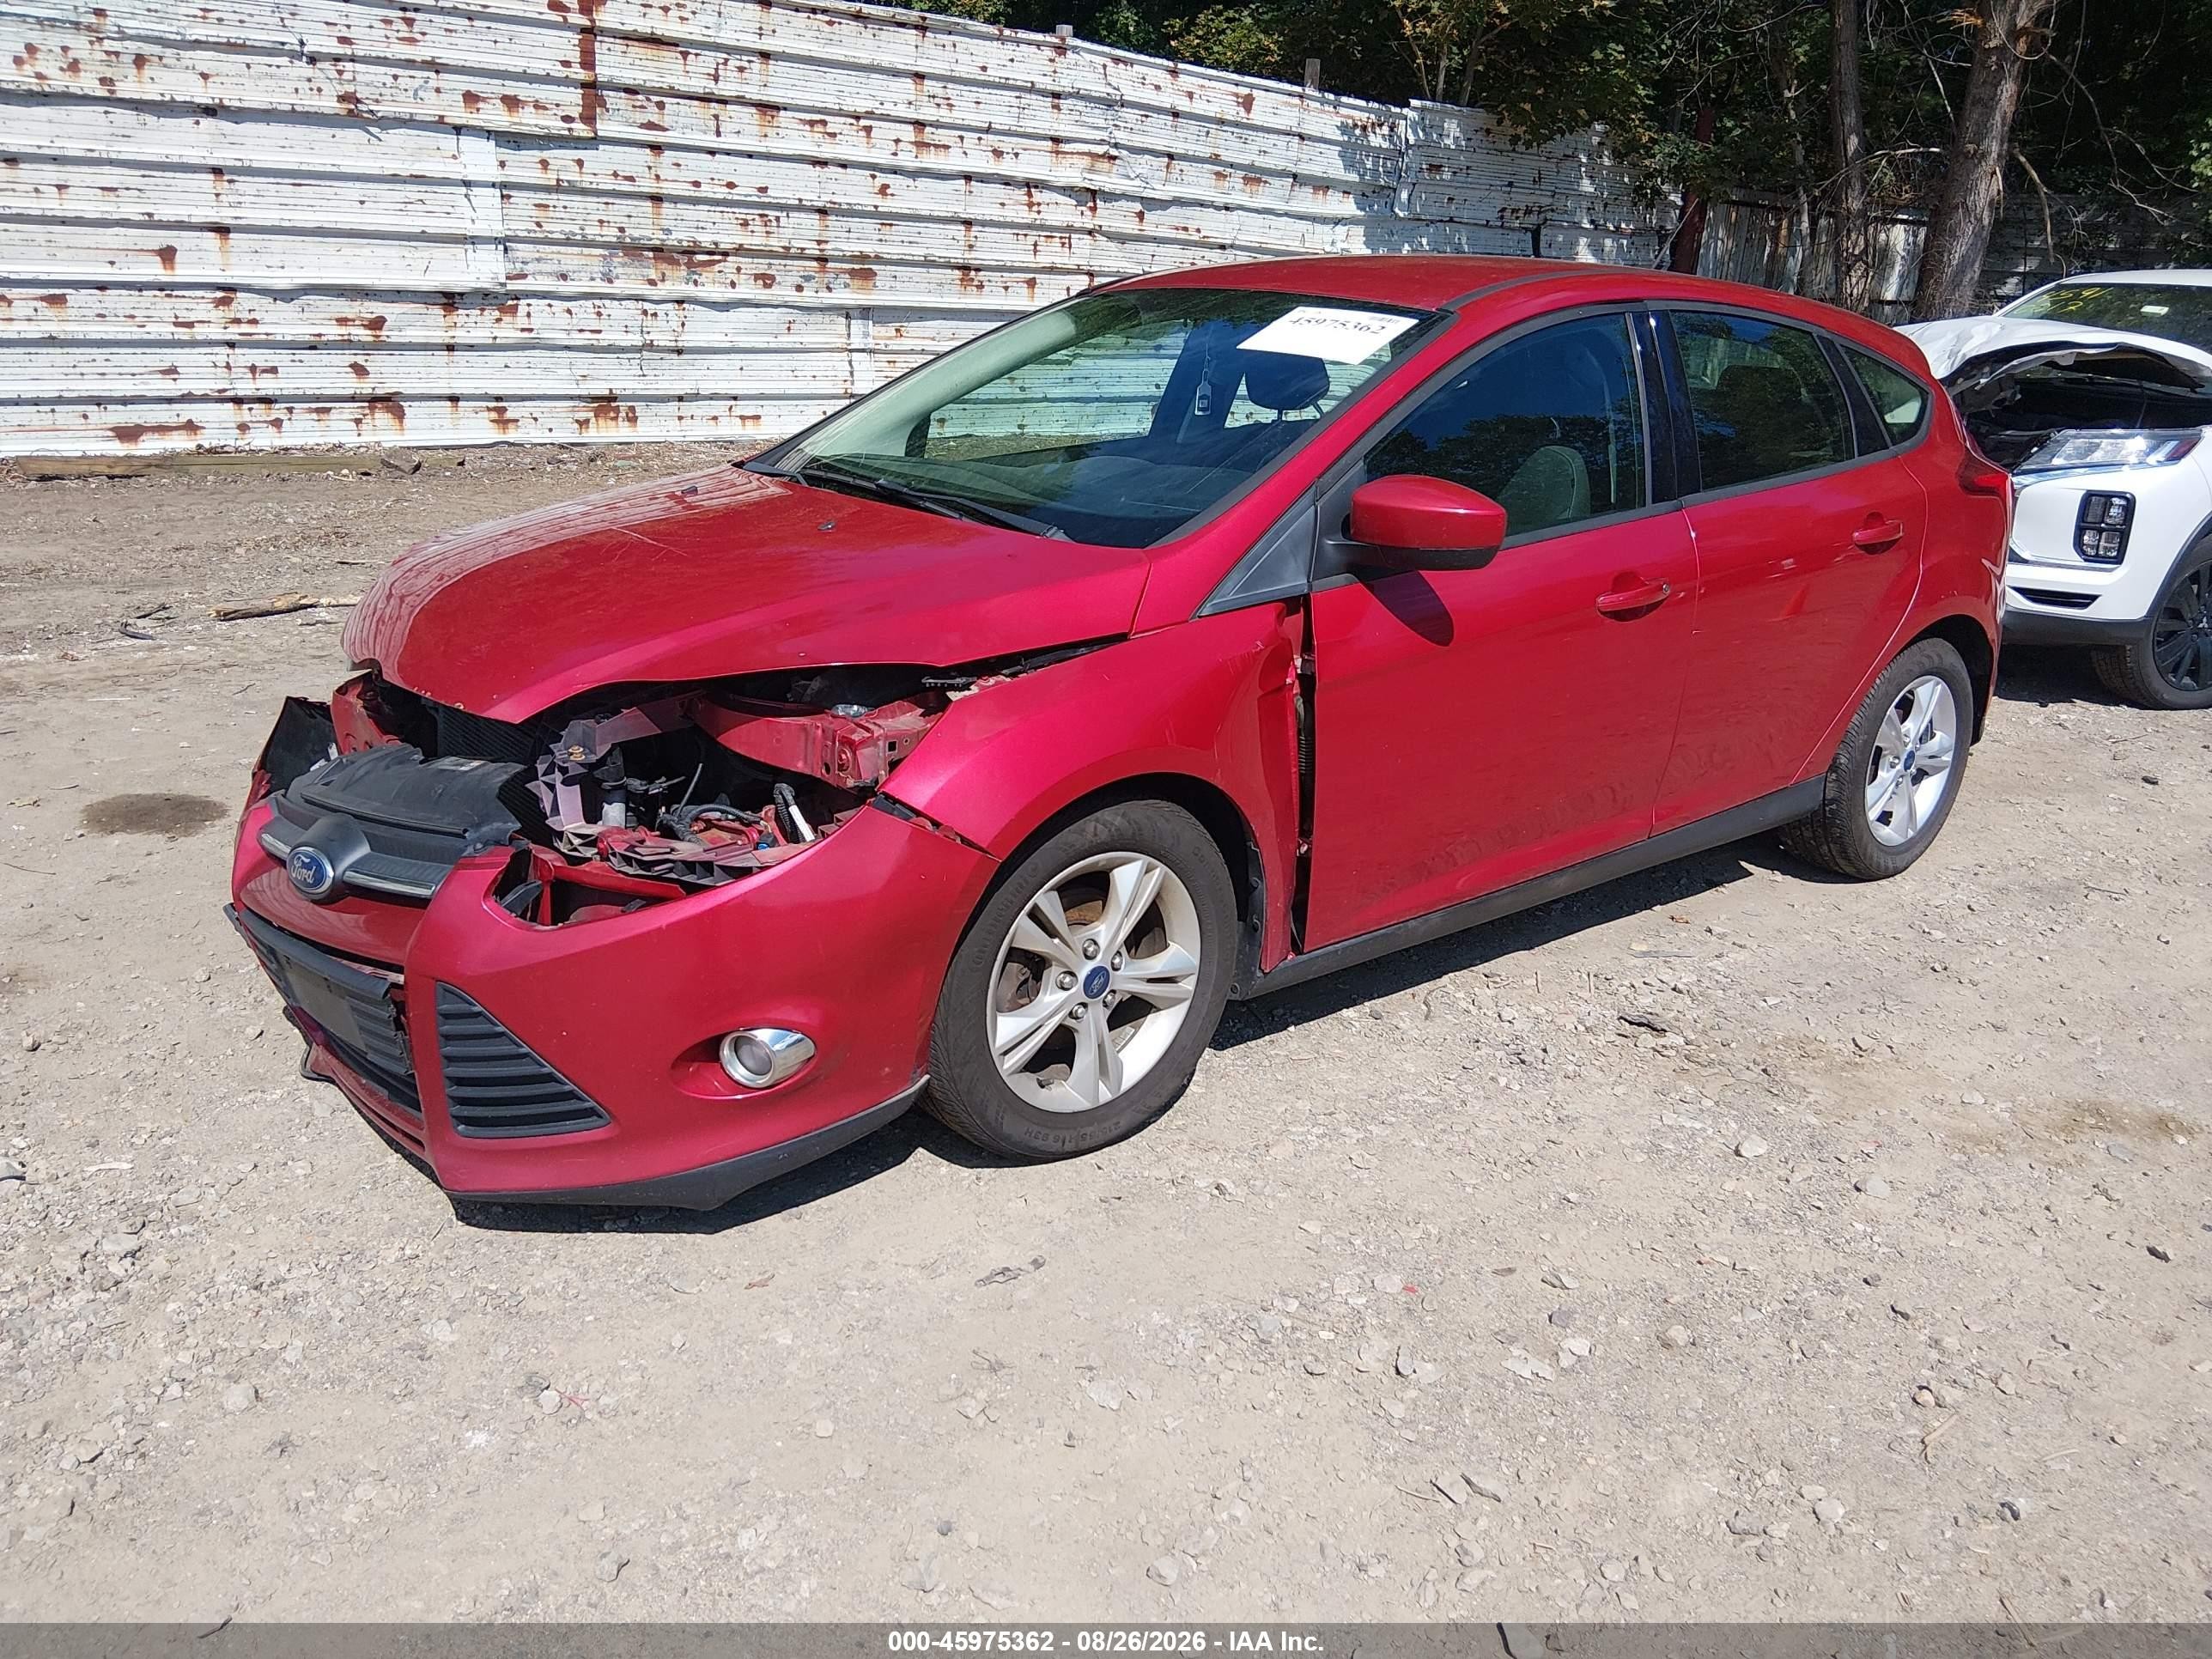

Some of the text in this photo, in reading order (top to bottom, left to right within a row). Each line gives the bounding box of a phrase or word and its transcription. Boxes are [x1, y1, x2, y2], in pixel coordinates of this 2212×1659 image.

[2036, 287, 2114, 303] 4591
[1288, 316, 1387, 335] 45975362
[291, 854, 317, 884] Ford
